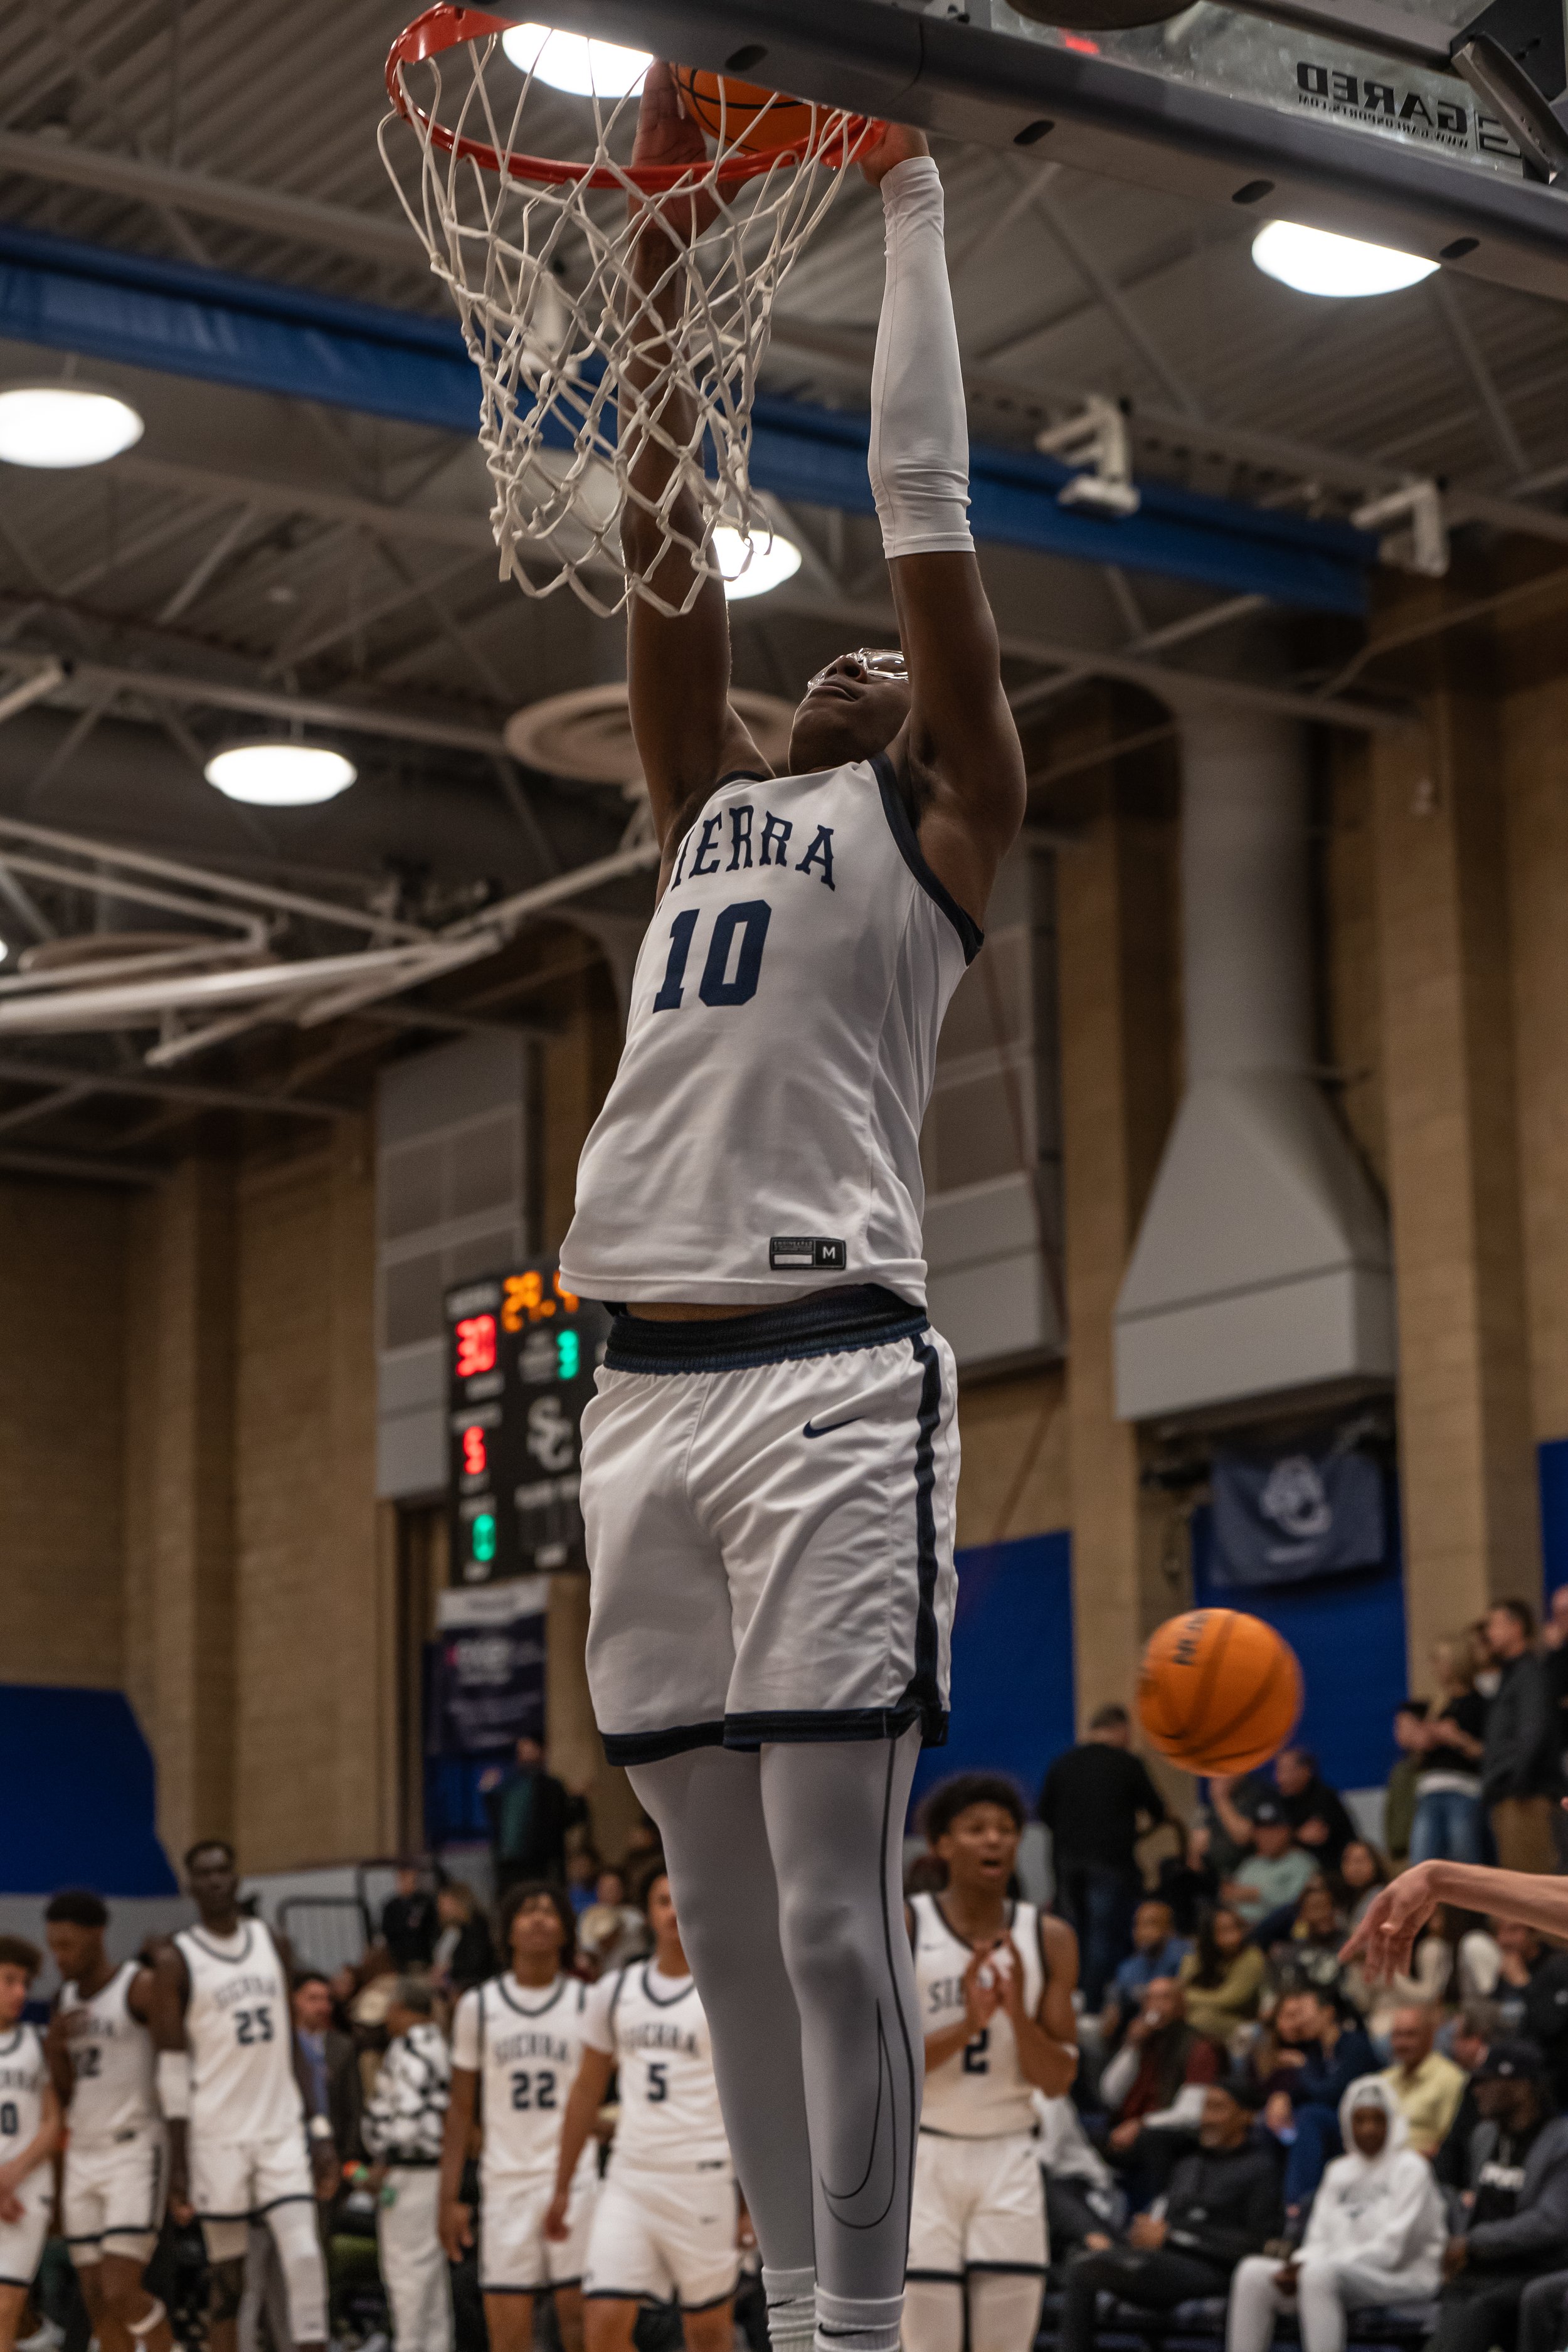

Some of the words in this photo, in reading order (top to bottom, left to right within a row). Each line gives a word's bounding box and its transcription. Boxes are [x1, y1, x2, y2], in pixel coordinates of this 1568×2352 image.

[669, 805, 835, 892] IERRA
[653, 899, 772, 1014] 10
[822, 1246, 835, 1259] M
[235, 2007, 273, 2046] 25
[963, 2027, 989, 2074] 2
[511, 2071, 556, 2111] 22
[647, 2062, 667, 2102] 5
